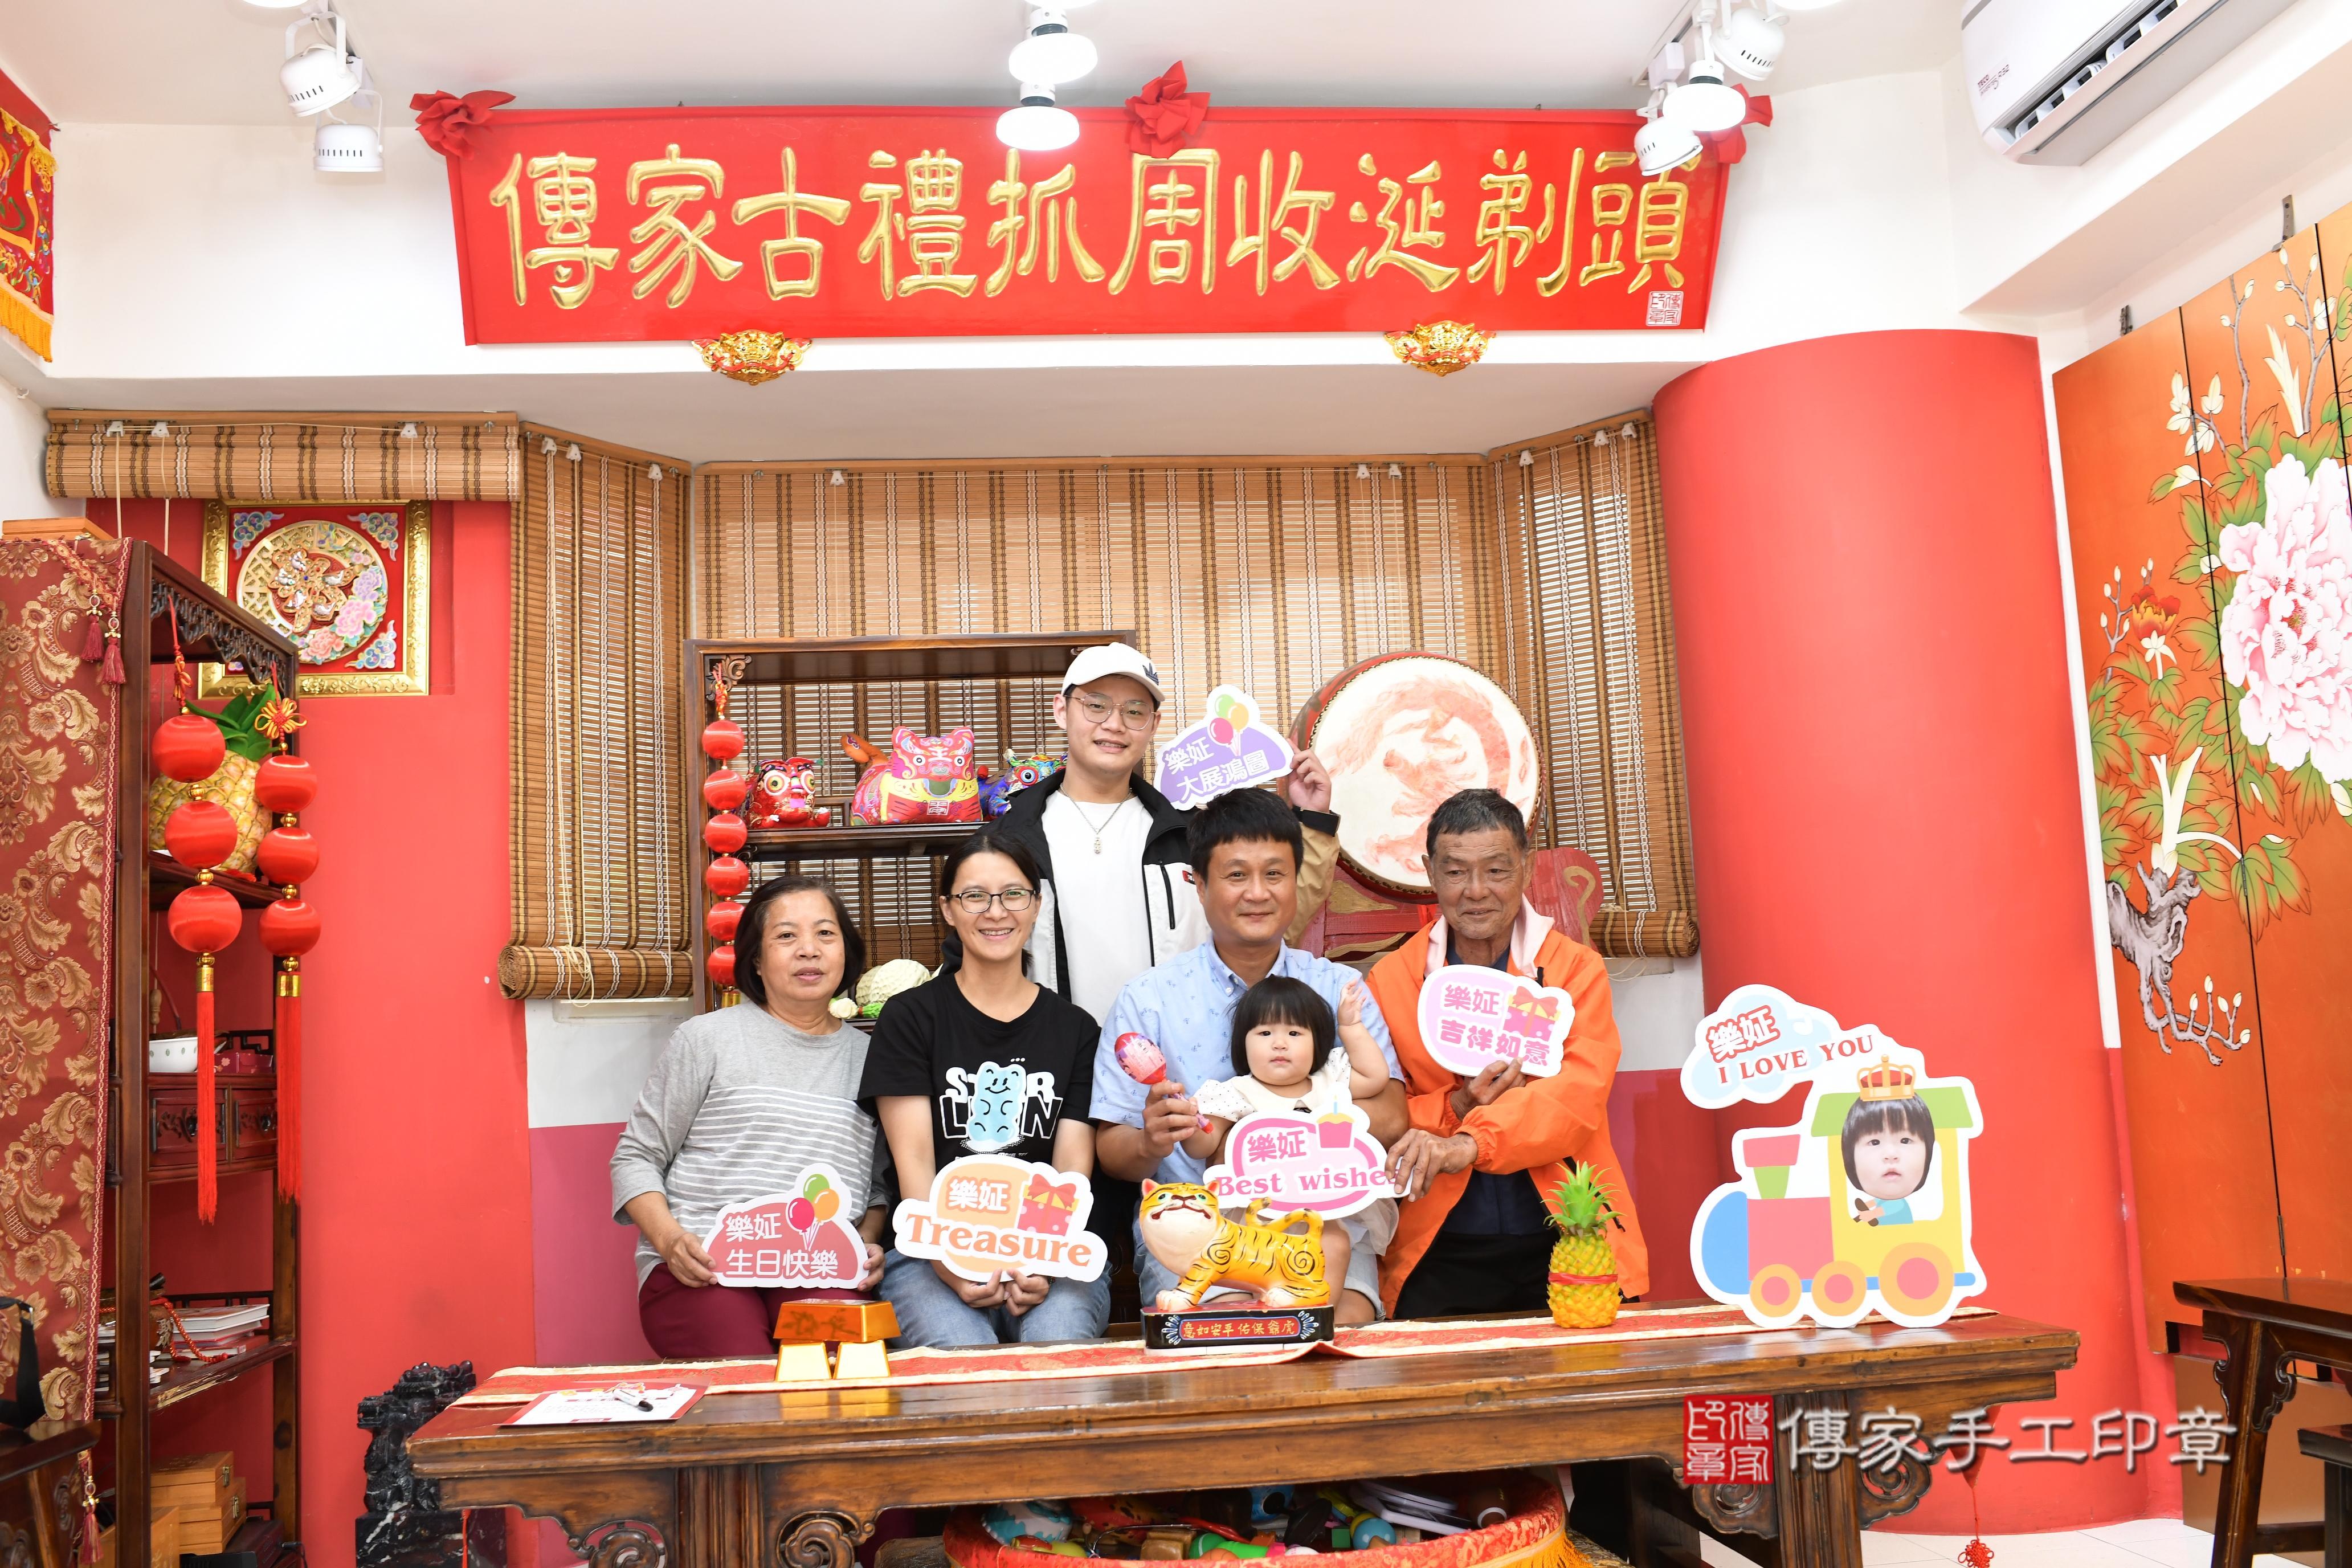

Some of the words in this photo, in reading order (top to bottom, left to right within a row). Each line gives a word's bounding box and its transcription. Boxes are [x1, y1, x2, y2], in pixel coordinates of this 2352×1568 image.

[489, 142, 1702, 309] 傳家古禮抓周收涎剃頭
[1165, 737, 1215, 775] 樂姃
[1176, 749, 1270, 801] 大展鴻圖
[1444, 984, 1500, 1015] 樂姃
[1440, 1019, 1550, 1067] 吉祥如意
[1708, 1007, 1778, 1060] 樂姃
[1718, 1066, 1728, 1084] I
[1740, 1050, 1807, 1079] LOVE
[1819, 1035, 1873, 1061] YOU
[1247, 1130, 1306, 1162] 樂姃
[948, 1178, 1009, 1211] 樂姃
[1215, 1173, 1282, 1196] Best
[726, 1212, 782, 1242] 樂姃
[906, 1213, 1092, 1267] Treasure
[726, 1248, 839, 1276] 生日快樂
